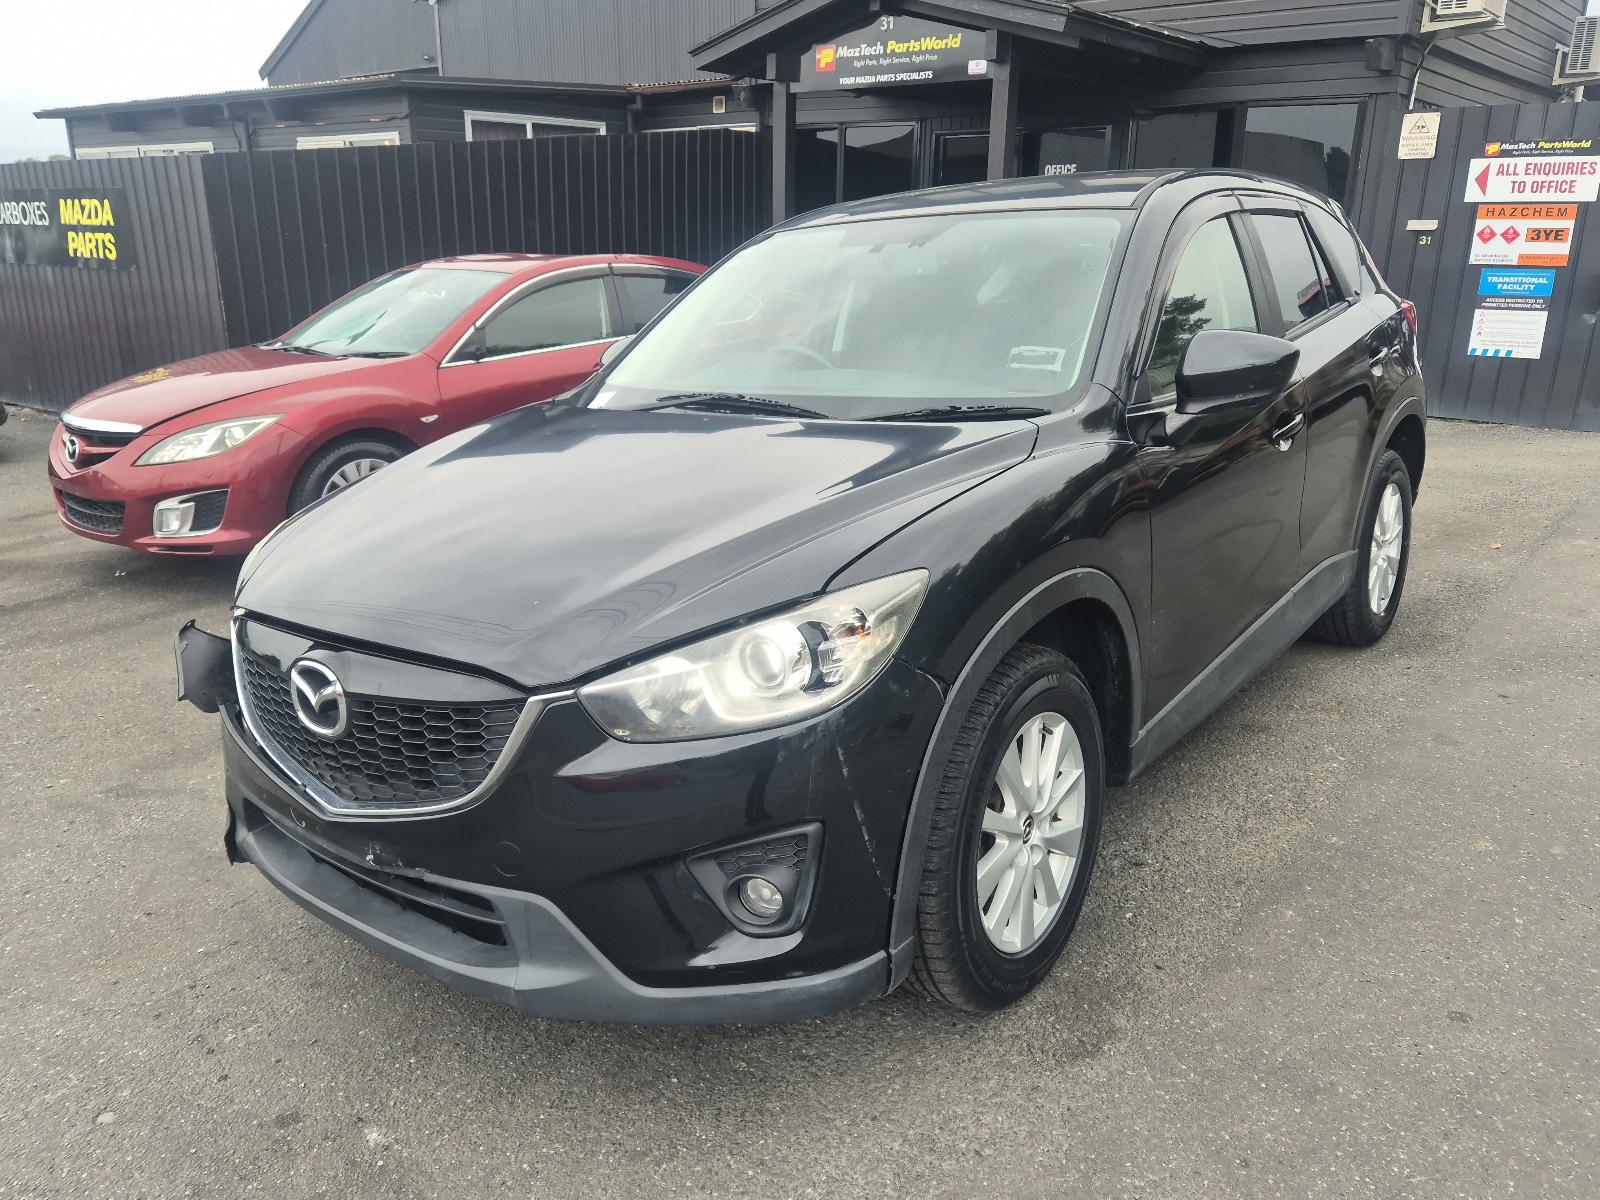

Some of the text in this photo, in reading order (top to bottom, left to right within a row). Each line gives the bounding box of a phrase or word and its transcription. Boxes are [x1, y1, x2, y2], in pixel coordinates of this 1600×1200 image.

[880, 16, 894, 30] 31
[836, 33, 962, 58] MazTech PartsWorld
[880, 57, 892, 66] Right
[912, 54, 924, 63] Right
[925, 53, 938, 61] Price
[840, 70, 934, 85] YOUR MAZDA PARTS SPECIALISTS
[1500, 140, 1592, 150] MazTech PartsWorld
[1044, 163, 1077, 176] OFFICE
[1496, 161, 1598, 177] ALL ENQUIRIES
[1510, 180, 1577, 194] TO OFFICE
[59, 198, 115, 227] MAZDA
[1485, 207, 1568, 217] HAZCHEM
[1419, 236, 1432, 245] 31
[1530, 229, 1565, 241] 3YE
[67, 231, 117, 261] PARTS
[1487, 276, 1549, 284] TRANSITIONAL
[1497, 283, 1536, 291] FACILITY
